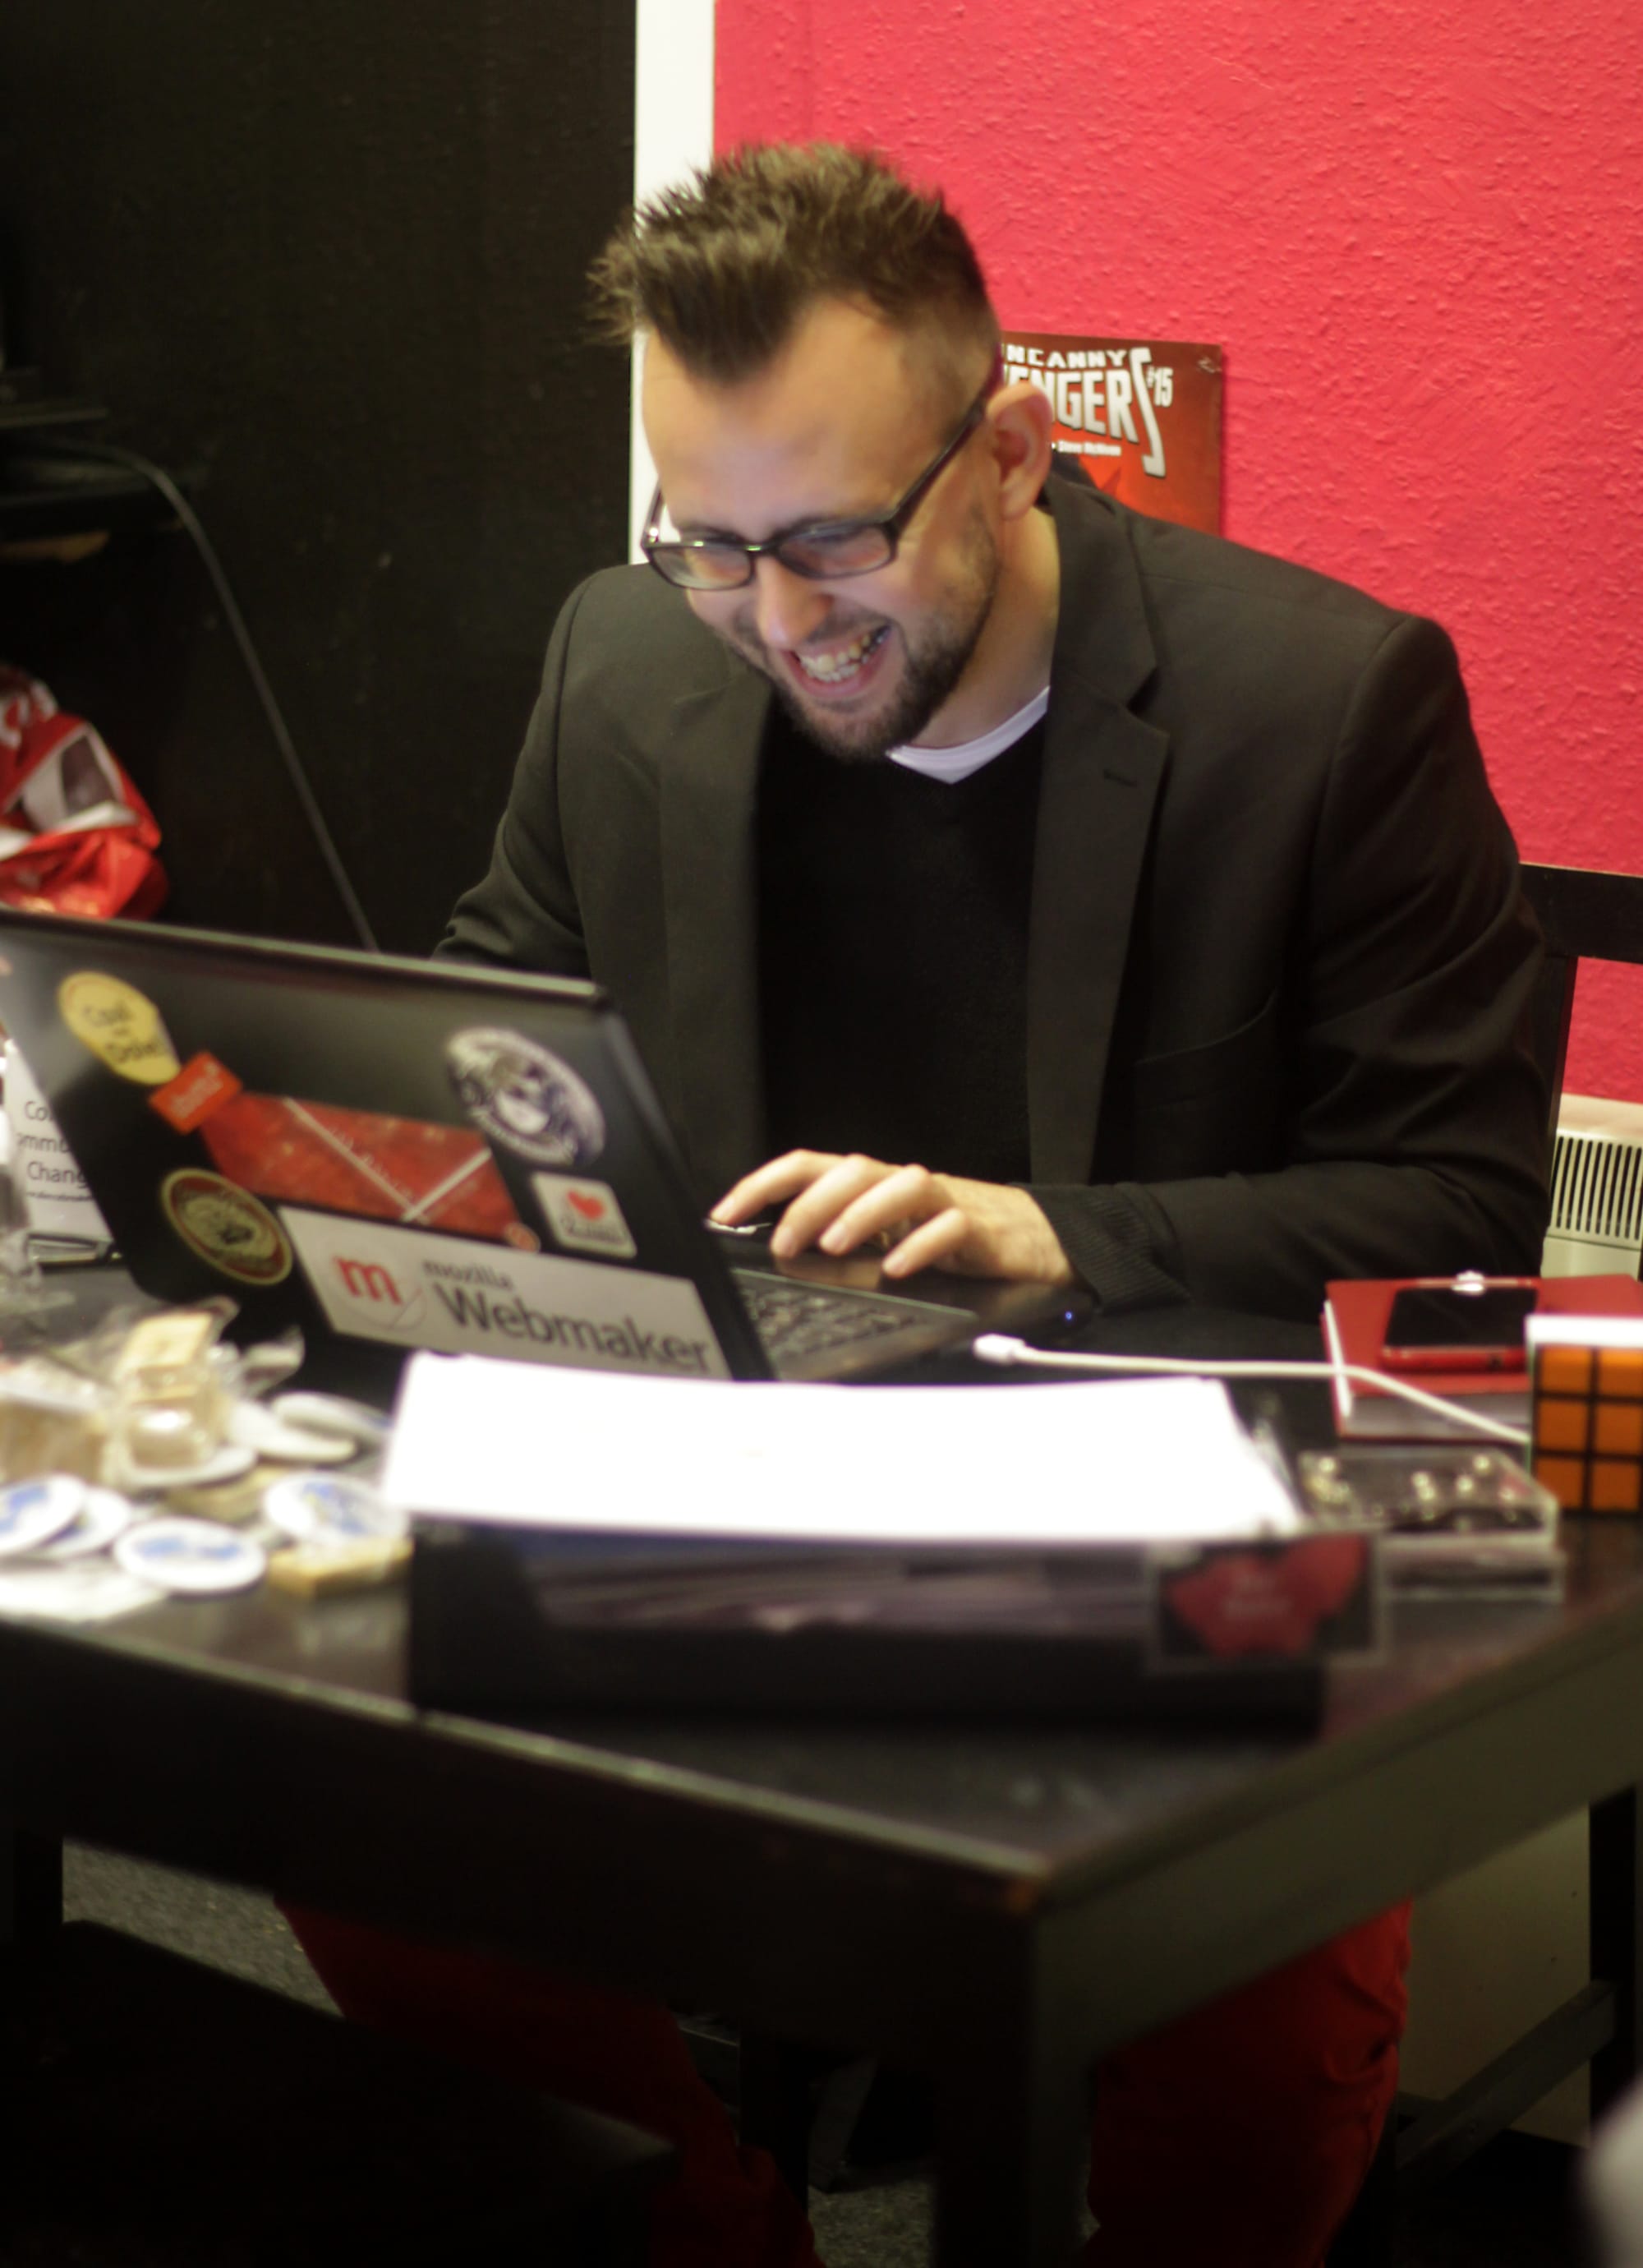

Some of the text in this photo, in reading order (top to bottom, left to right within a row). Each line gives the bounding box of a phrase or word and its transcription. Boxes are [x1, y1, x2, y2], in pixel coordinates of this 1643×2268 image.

[1001, 343, 1126, 369] NCANNY
[25, 1100, 52, 1122] Co
[421, 1259, 513, 1291] mozilla
[432, 1281, 711, 1373] Webmaker
